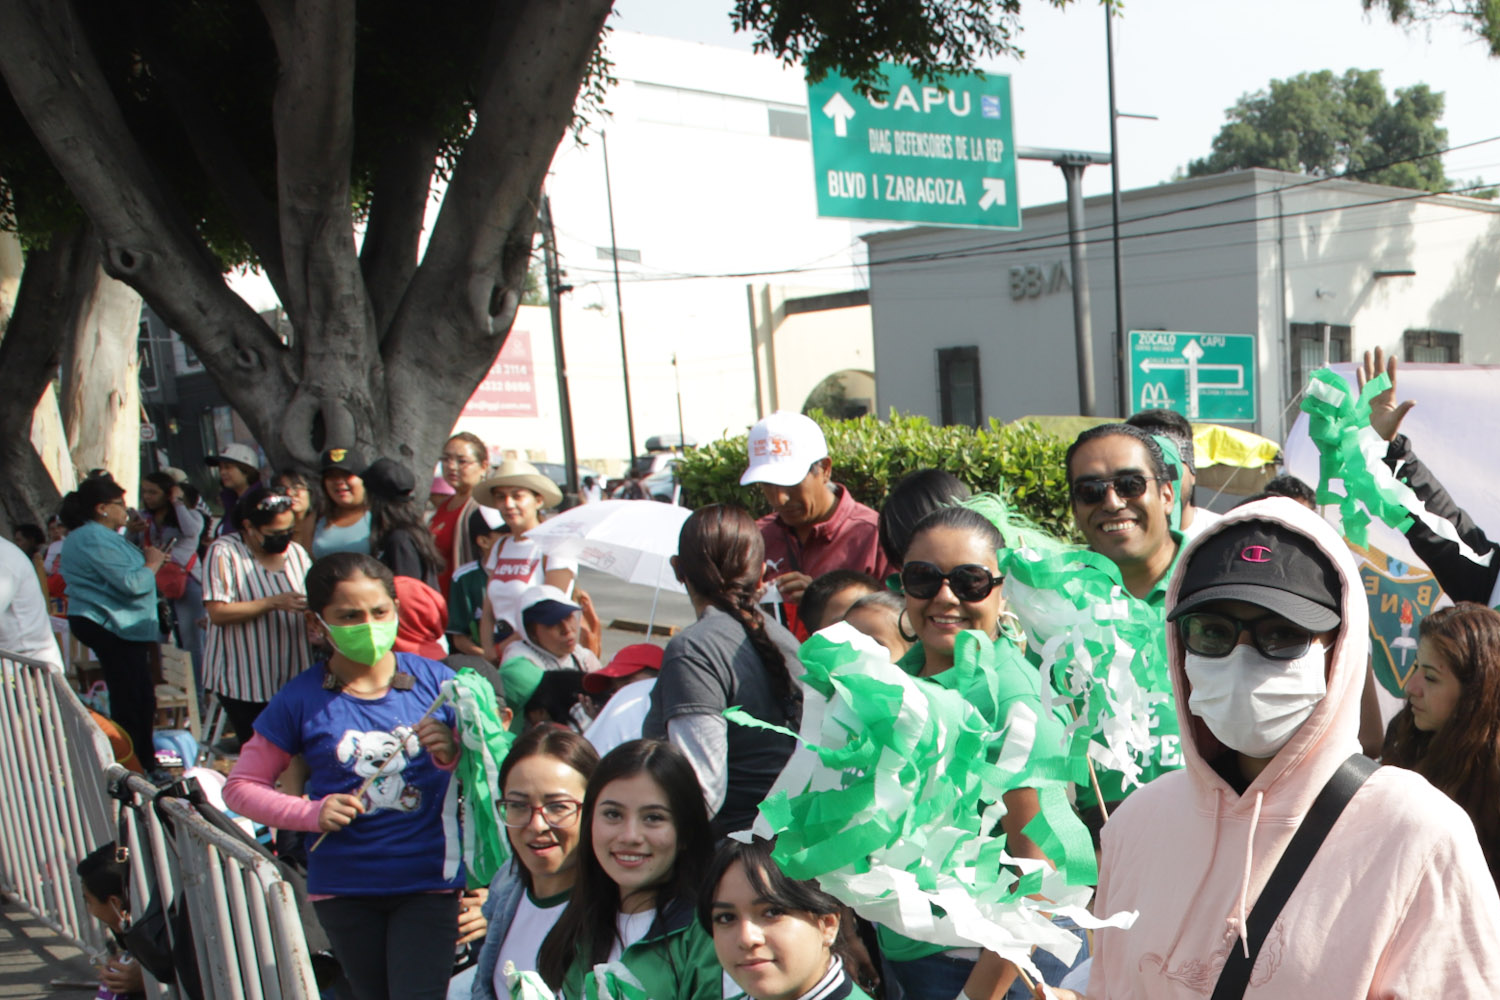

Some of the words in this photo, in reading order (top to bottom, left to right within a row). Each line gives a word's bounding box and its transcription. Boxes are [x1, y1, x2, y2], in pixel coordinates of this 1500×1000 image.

[868, 128, 892, 154] DIAG
[894, 130, 954, 160] DEFENSORES
[955, 136, 969, 161] DE
[970, 137, 985, 162] LA
[985, 138, 1004, 163] REP
[828, 169, 867, 199] BLVD
[884, 174, 967, 206] ZARAGOZA
[1008, 263, 1073, 300] BBVA
[1199, 335, 1226, 347] CAPU
